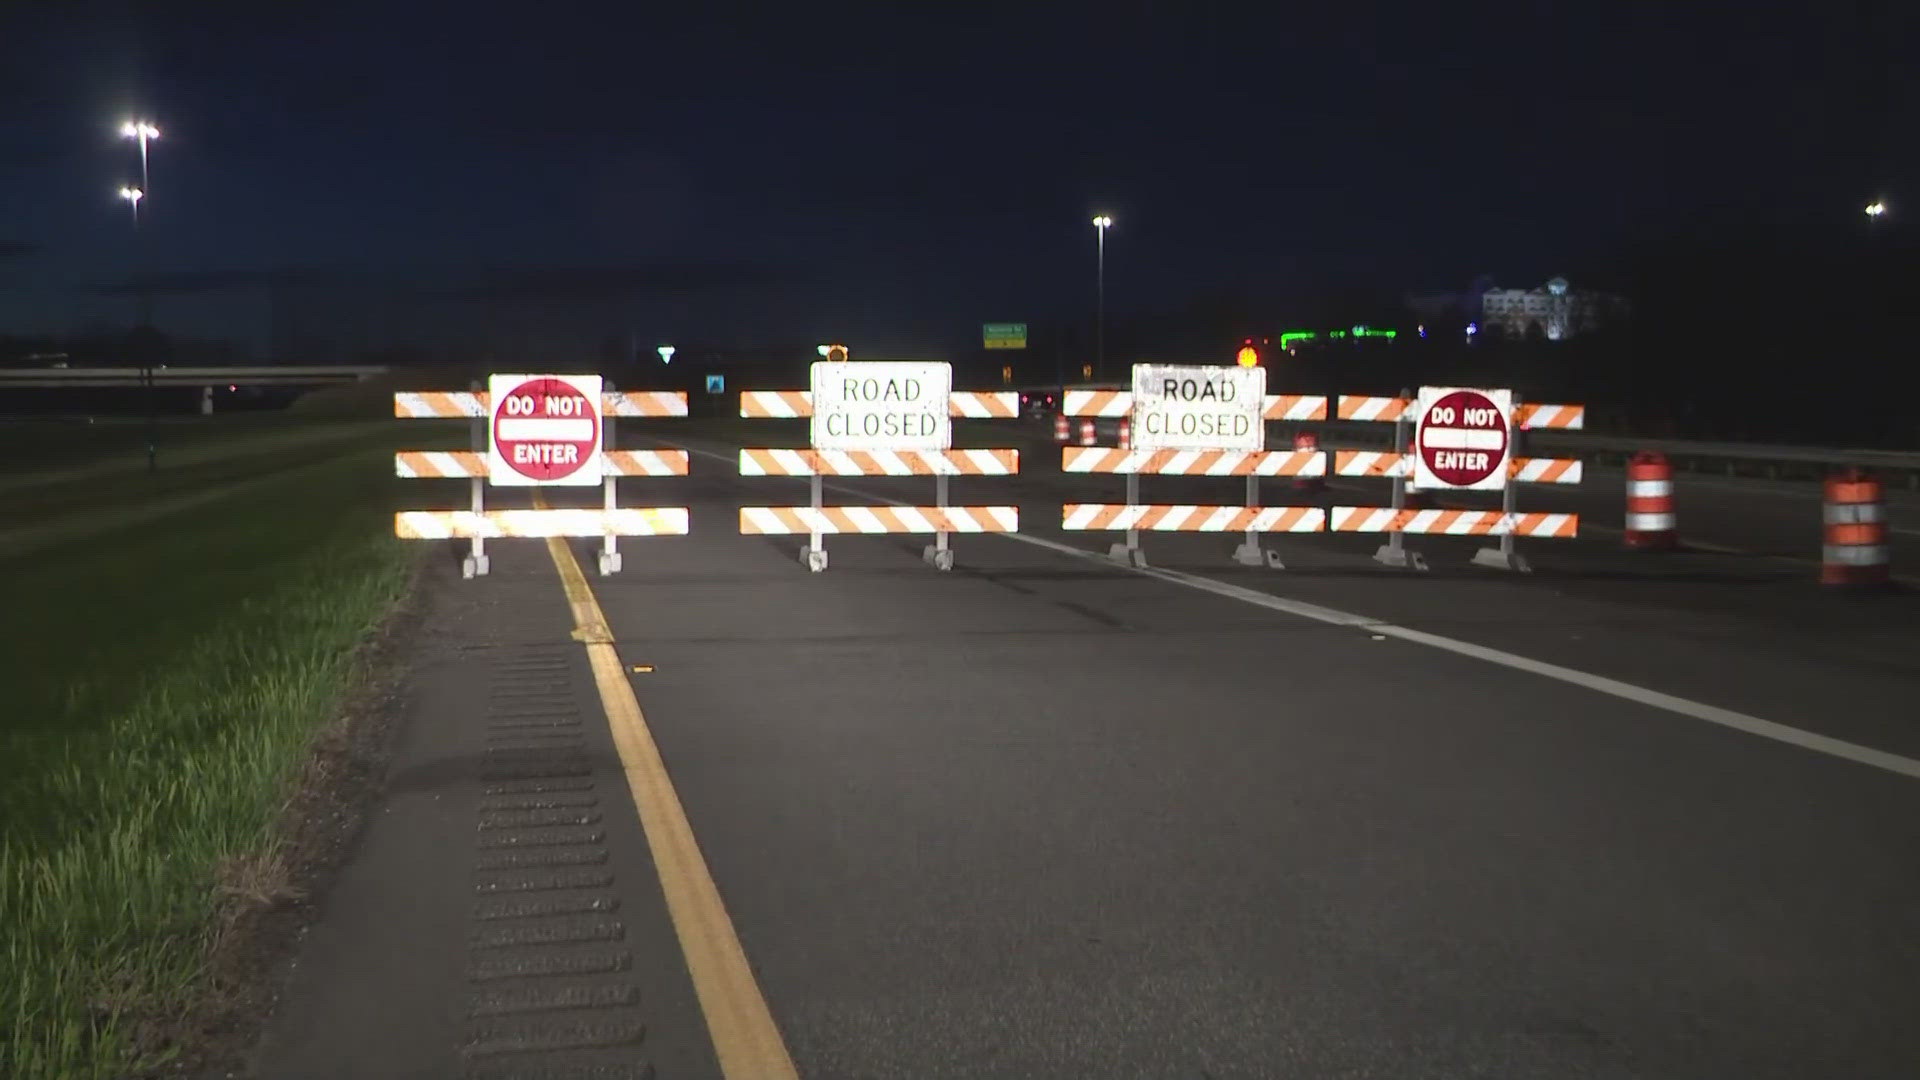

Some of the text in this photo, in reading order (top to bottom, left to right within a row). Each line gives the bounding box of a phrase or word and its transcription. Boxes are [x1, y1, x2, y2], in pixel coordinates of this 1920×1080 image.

[844, 379, 920, 401] ROAD
[1164, 379, 1236, 402] ROAD
[506, 395, 584, 416] DO NOT
[827, 413, 936, 436] CLOSED
[1146, 413, 1249, 436] CLOSED
[1431, 407, 1498, 427] DO NOT
[514, 444, 578, 464] ENTER
[1434, 451, 1489, 471] ENTER
